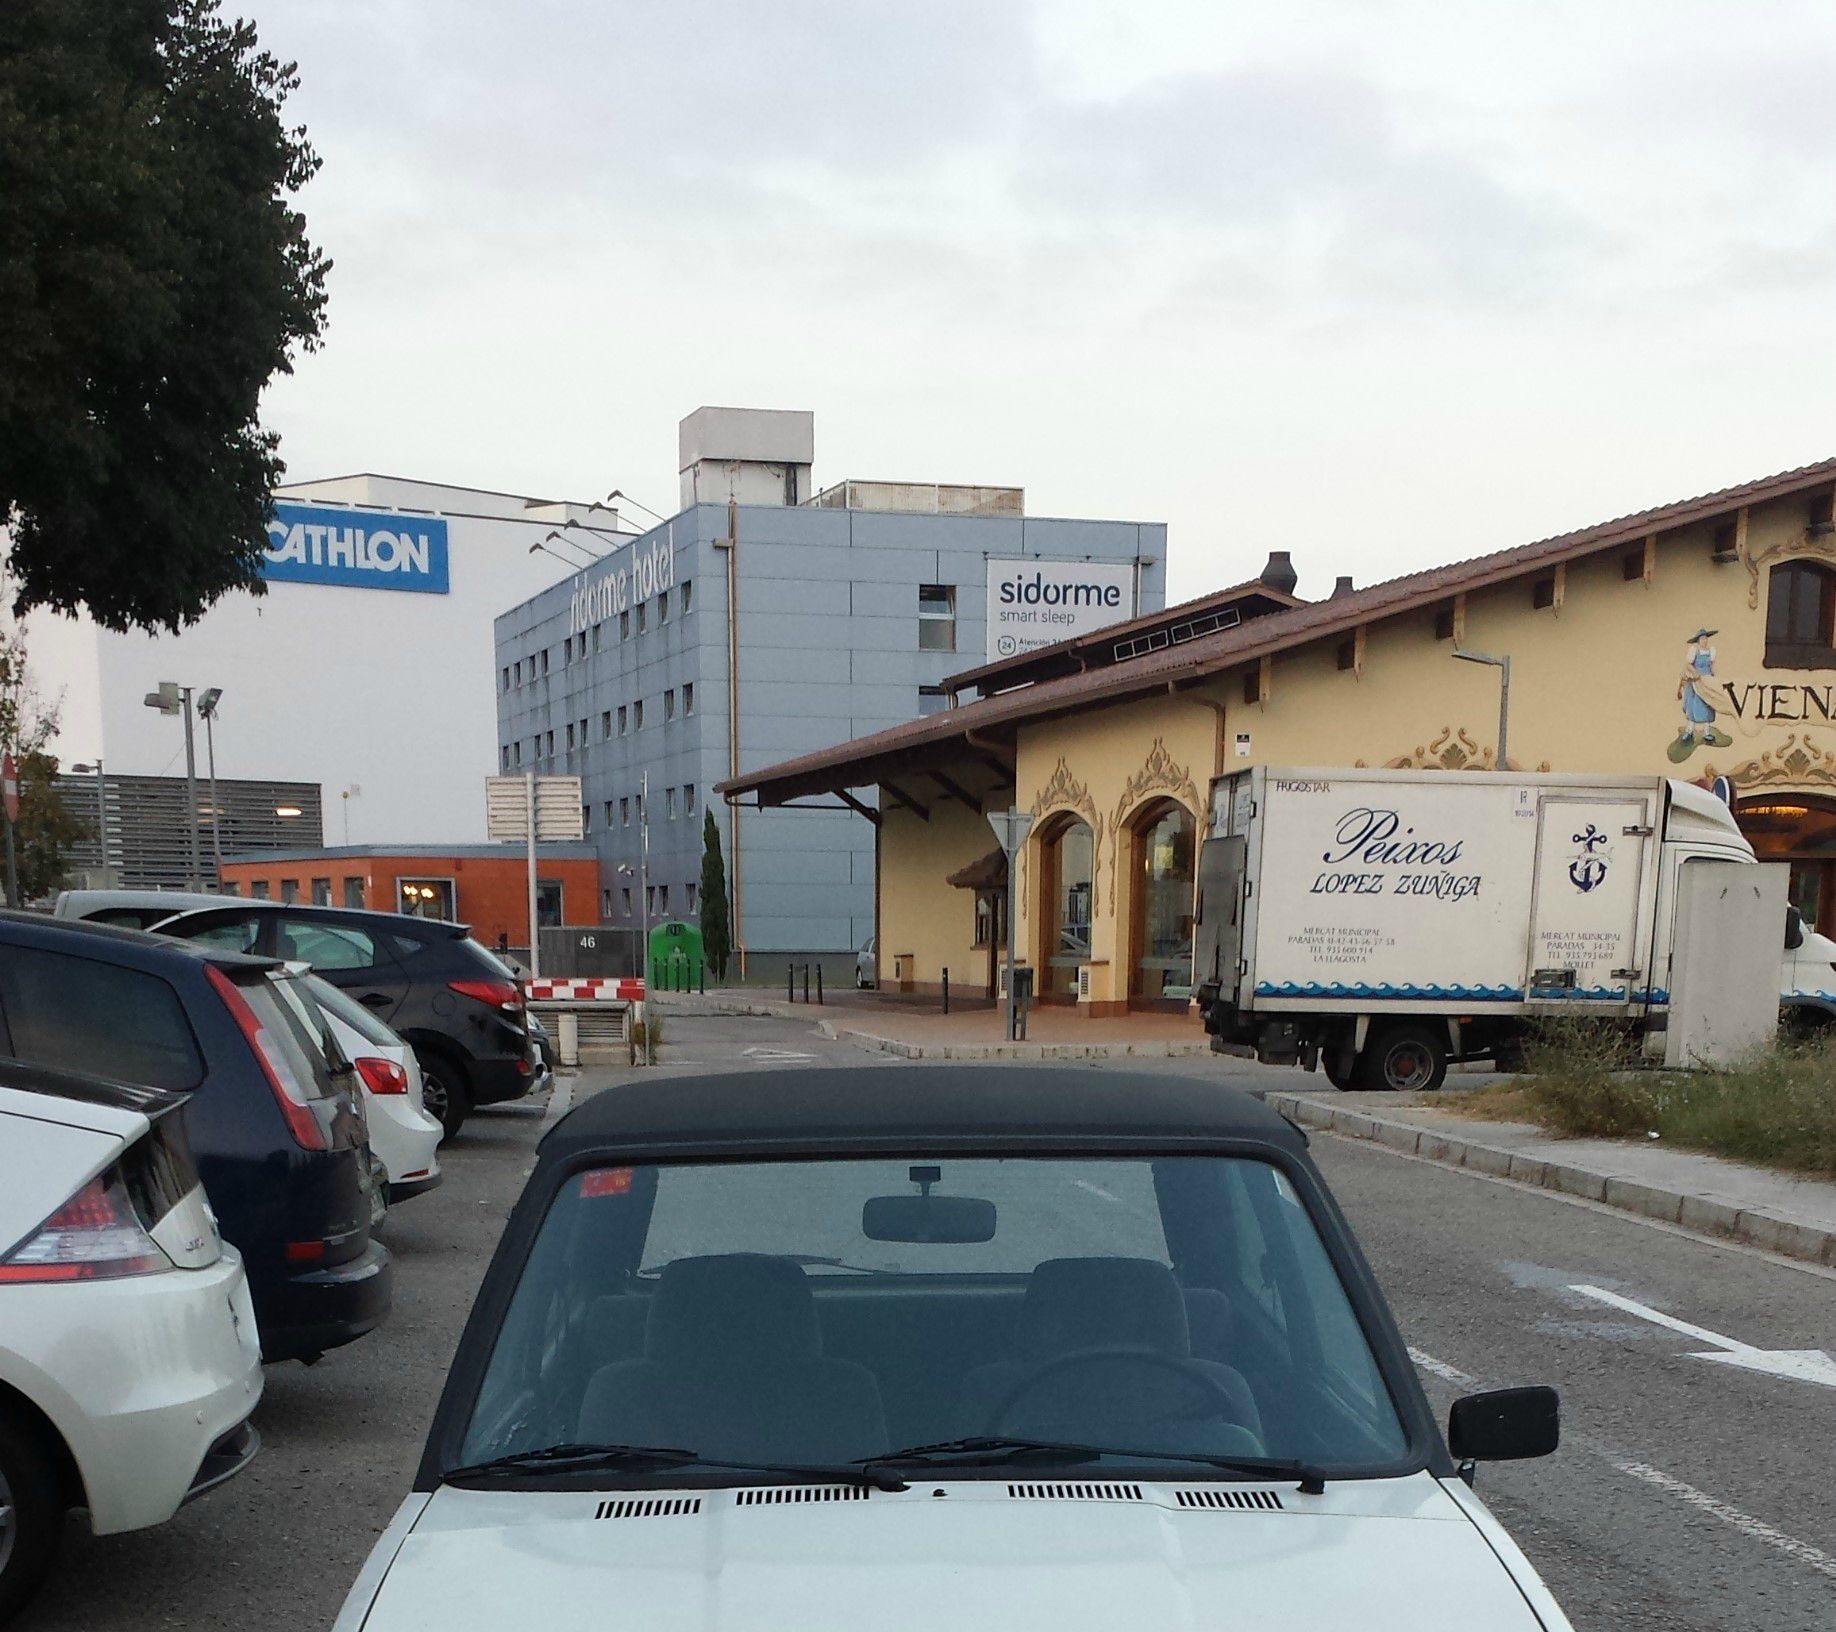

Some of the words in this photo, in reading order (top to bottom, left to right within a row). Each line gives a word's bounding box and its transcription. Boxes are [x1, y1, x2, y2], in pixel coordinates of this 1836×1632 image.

[262, 520, 430, 574] CATHLON
[570, 567, 627, 636] sidorme
[632, 523, 674, 605] hotel
[999, 572, 1121, 607] sidorme
[1000, 610, 1037, 623] smart
[1041, 608, 1075, 627] sleep
[1322, 807, 1464, 865] Peixos
[1309, 873, 1385, 894] LOPEZ
[1393, 870, 1482, 903] ZUÑIGA
[1288, 936, 1325, 944] PARADAS
[1303, 927, 1335, 935] MERCAT
[1338, 927, 1381, 937] MUNICIPAL
[1541, 932, 1575, 941] MERCAT
[1577, 932, 1621, 942] MUNICIPAL
[580, 936, 596, 948] 46
[1547, 942, 1585, 950] PARADAS
